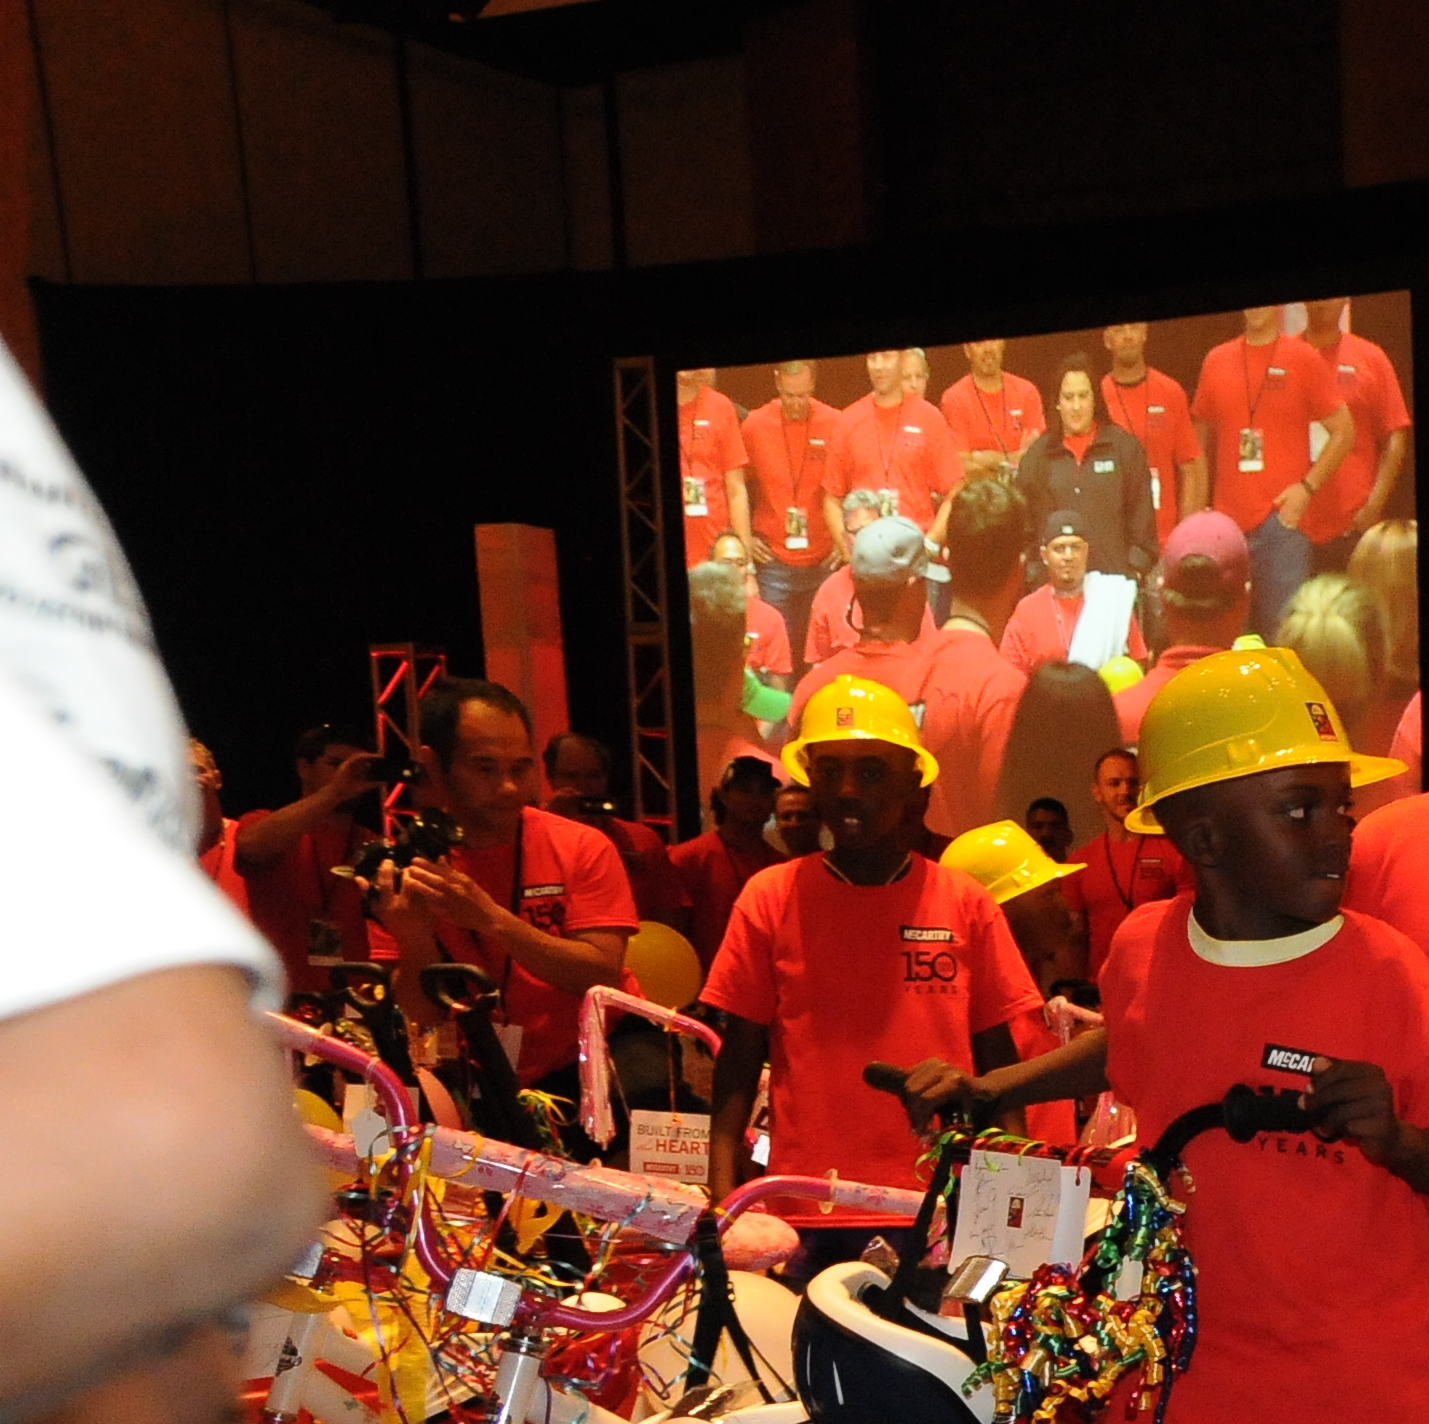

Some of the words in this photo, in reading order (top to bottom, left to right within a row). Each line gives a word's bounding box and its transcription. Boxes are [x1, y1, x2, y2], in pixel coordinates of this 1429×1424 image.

[901, 951, 958, 983] 150
[1266, 1049, 1316, 1073] McCA
[637, 1124, 672, 1137] BUILT
[676, 1126, 711, 1140] FROM
[655, 1138, 711, 1156] HEART
[1258, 1136, 1345, 1165] YEARS
